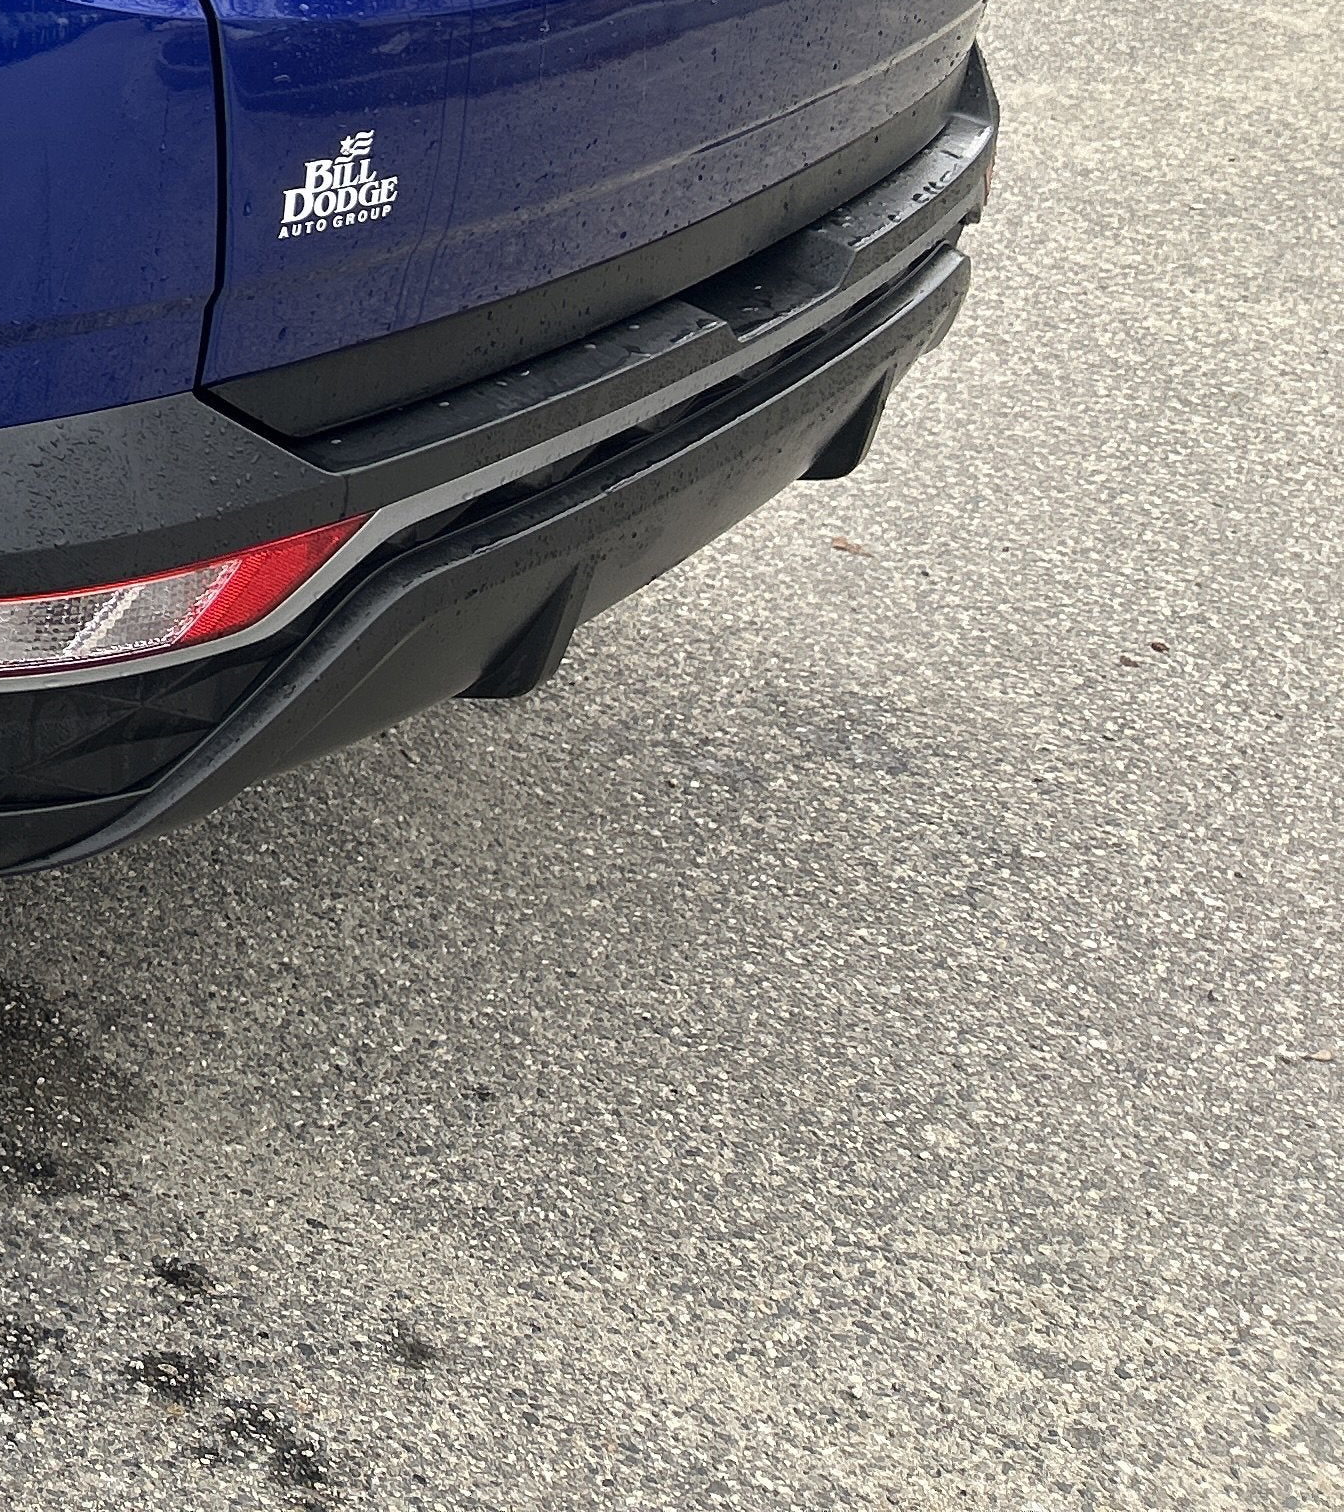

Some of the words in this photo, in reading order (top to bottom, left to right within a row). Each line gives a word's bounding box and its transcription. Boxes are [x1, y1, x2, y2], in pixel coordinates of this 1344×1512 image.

[303, 157, 377, 193] BILL
[280, 175, 399, 224] DODGE
[277, 218, 328, 240] AUTO
[332, 204, 393, 229] GROUP
